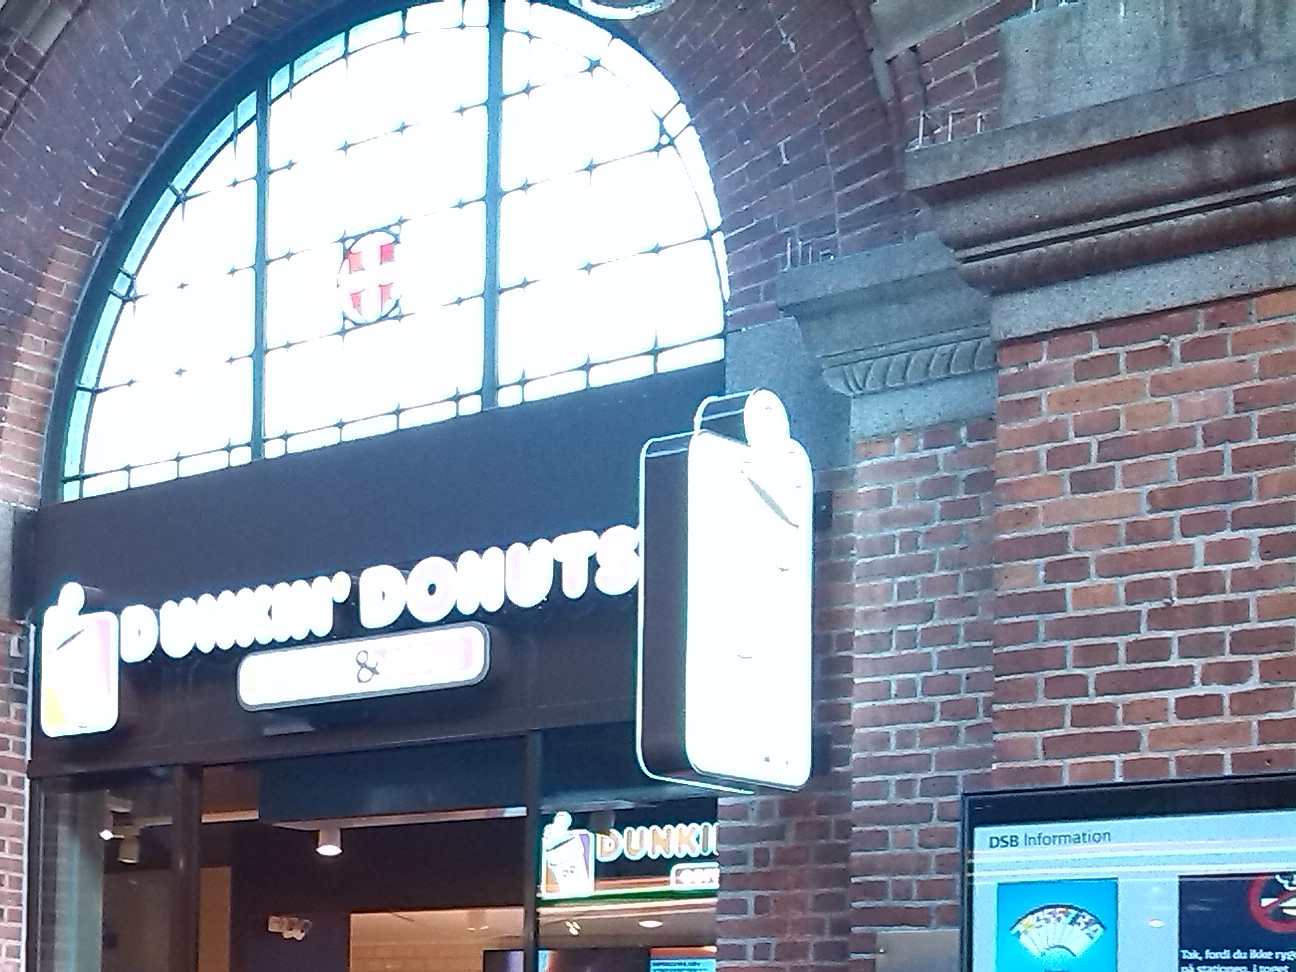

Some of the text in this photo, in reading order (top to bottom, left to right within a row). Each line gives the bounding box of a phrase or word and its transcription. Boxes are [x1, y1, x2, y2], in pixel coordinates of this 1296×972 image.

[120, 524, 640, 663] DUNKIN' DONUTS
[596, 822, 719, 862] DUNKI
[989, 830, 1111, 849] DSB Information
[1181, 949, 1202, 960] Tak,
[1205, 949, 1230, 959] fordi
[1233, 949, 1248, 959] du
[1250, 949, 1274, 959] ikke
